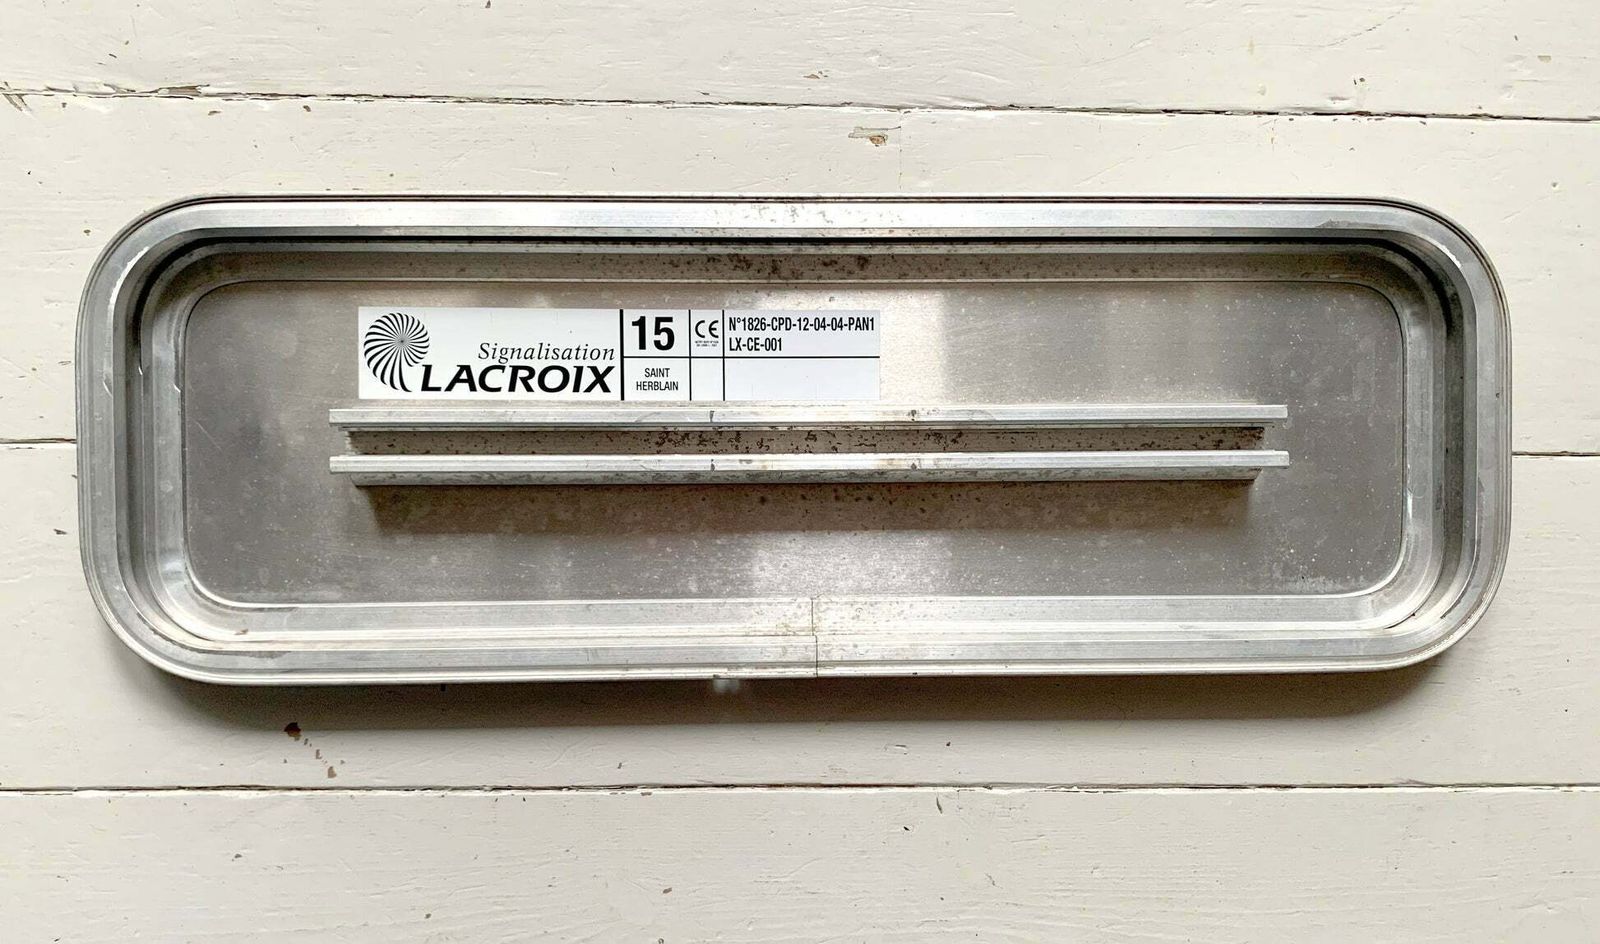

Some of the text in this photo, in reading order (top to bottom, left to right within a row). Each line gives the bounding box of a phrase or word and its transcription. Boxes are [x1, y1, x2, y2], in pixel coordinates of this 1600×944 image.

[631, 315, 675, 351] 15
[694, 319, 719, 338] CE
[478, 342, 615, 365] Signalisation
[728, 336, 783, 352] LX-CE-001
[421, 364, 615, 393] LACROIX
[644, 367, 670, 378] SAINT
[636, 380, 679, 391] HERBLAIN
